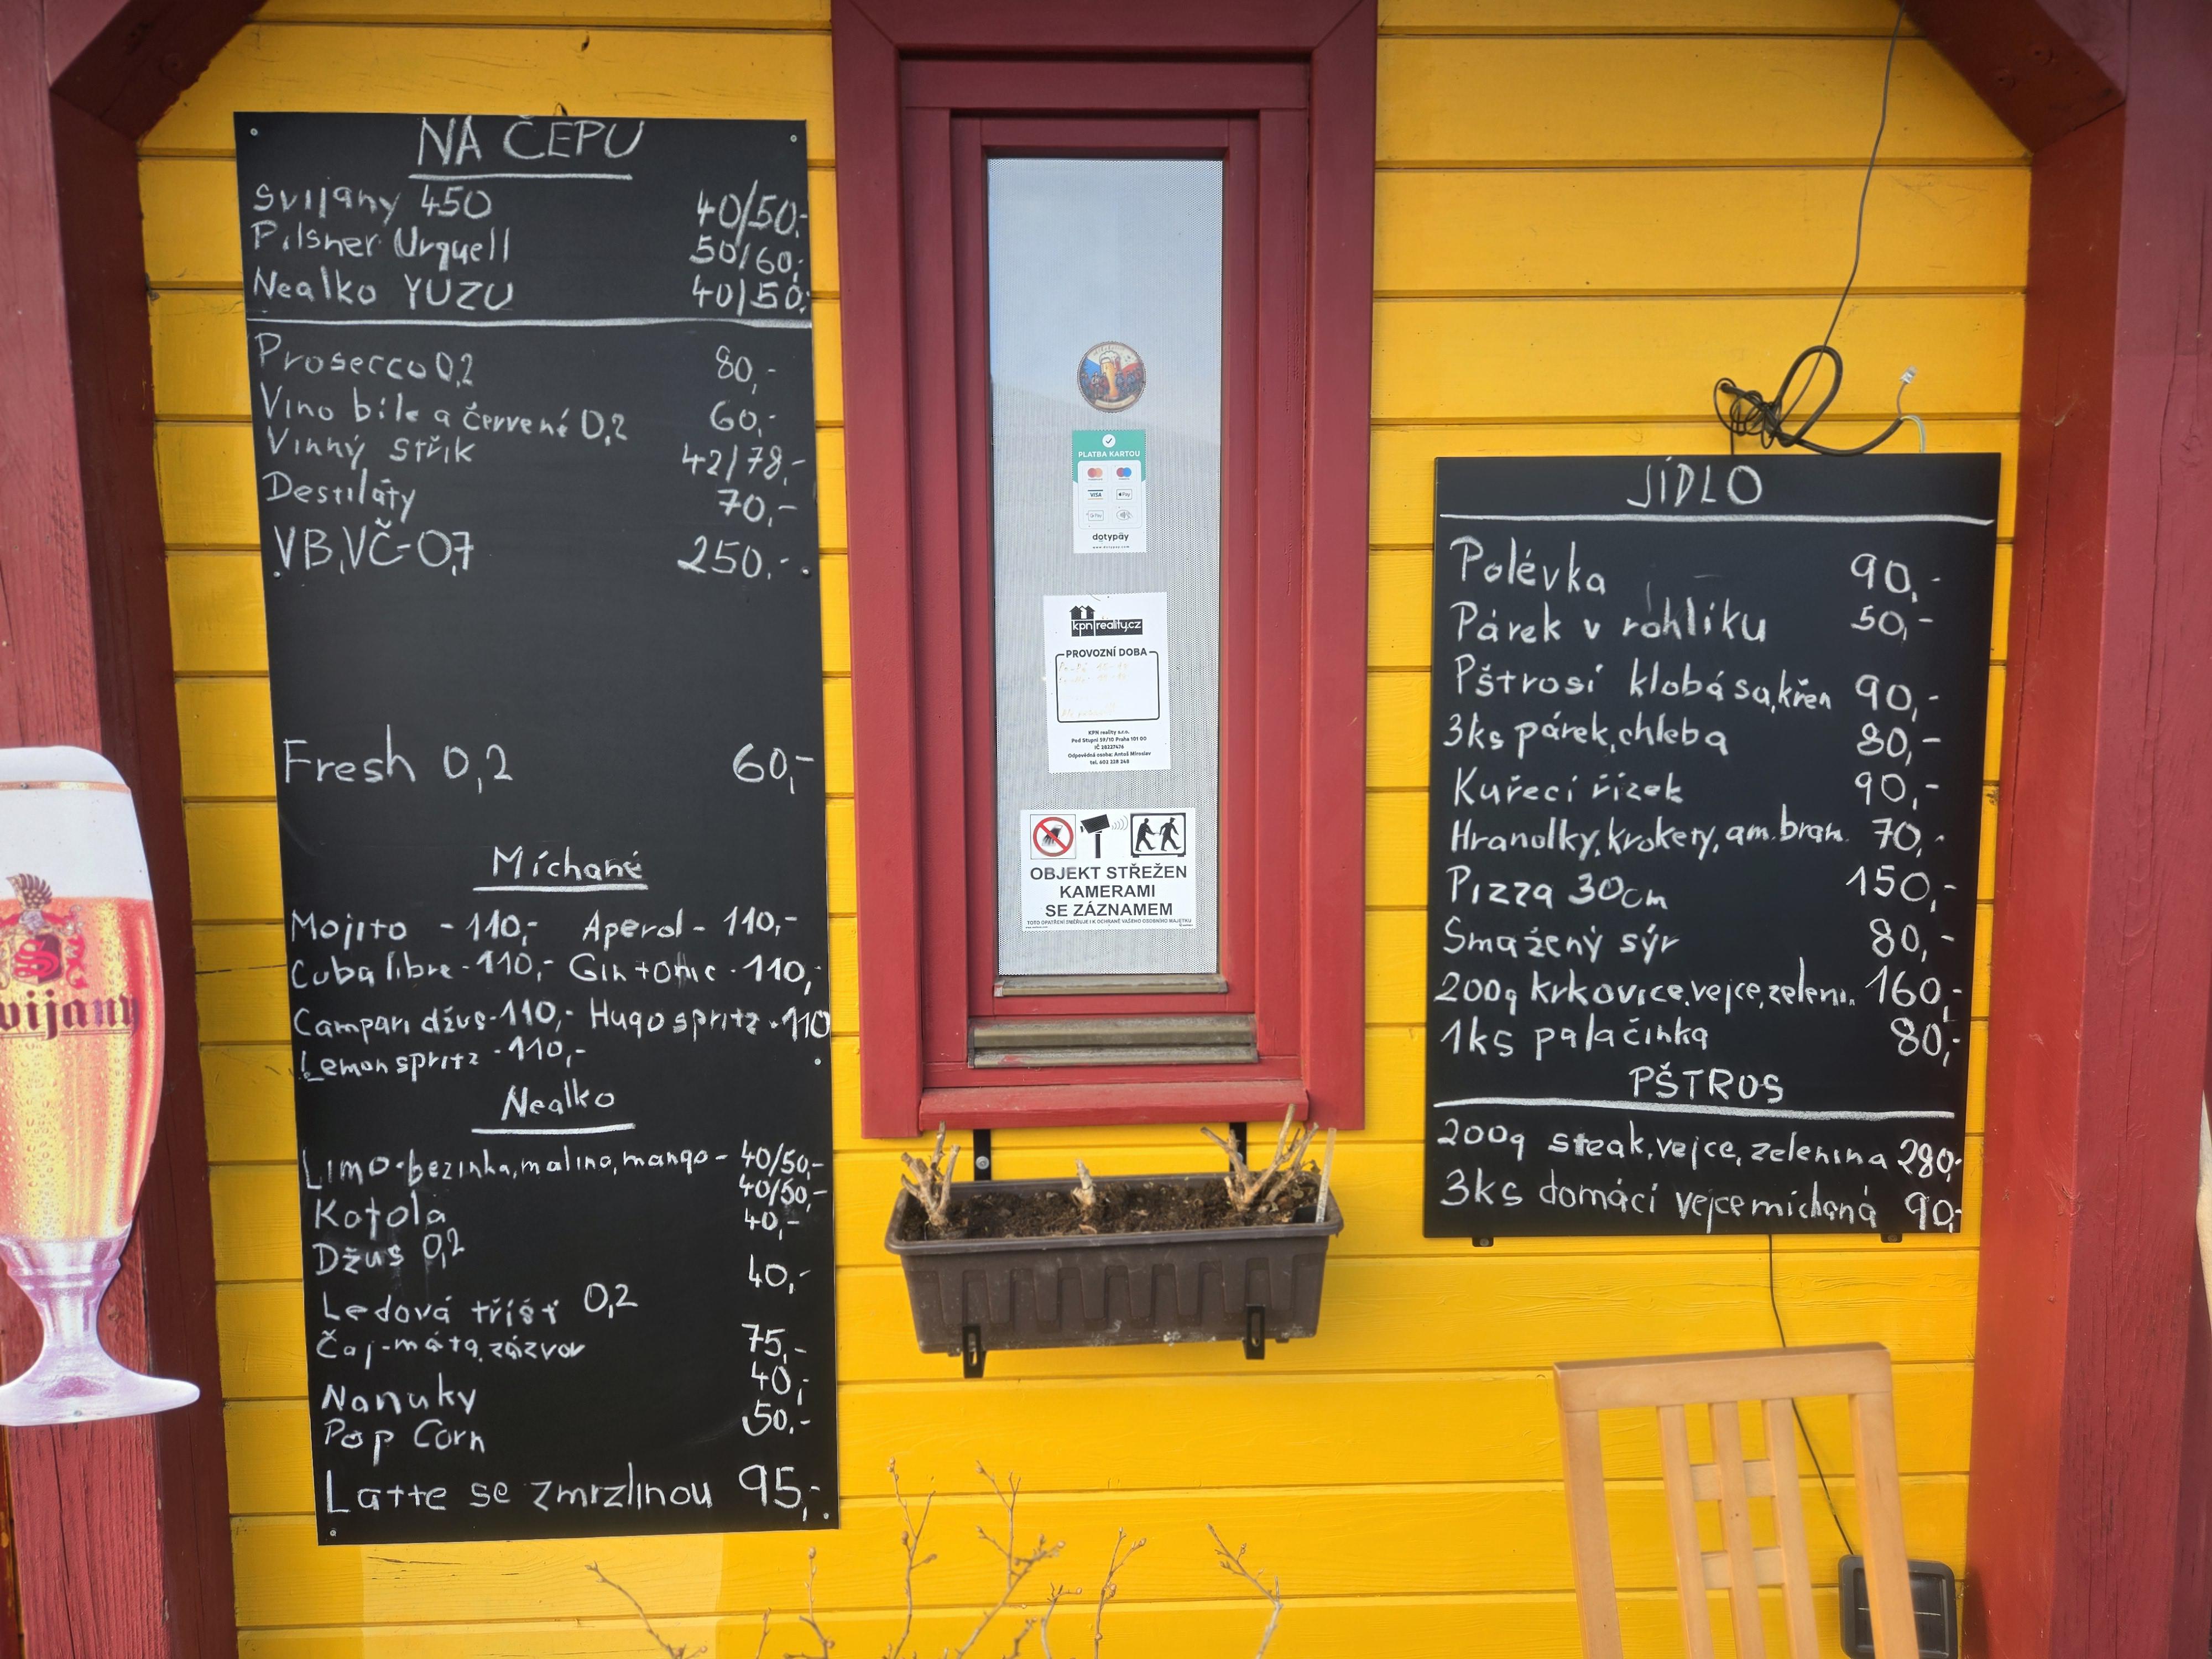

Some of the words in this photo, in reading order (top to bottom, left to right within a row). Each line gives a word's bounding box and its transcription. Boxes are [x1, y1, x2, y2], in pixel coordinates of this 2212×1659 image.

[418, 119, 482, 165] NA
[503, 114, 644, 159] ČEPU
[421, 184, 492, 219] 450
[252, 220, 380, 257] Pilsner
[254, 266, 376, 305] Nealko
[404, 274, 513, 311] YUZU
[255, 333, 426, 379] Prosecco
[436, 352, 472, 387] 0,2
[261, 382, 333, 420] Vino
[434, 410, 450, 427] a
[582, 409, 627, 446] 0,2
[268, 426, 365, 470] Vinný
[1627, 457, 1762, 508] JÍDLO
[717, 489, 796, 527] 70,-
[677, 535, 789, 580] 250,-
[1450, 536, 1605, 595] Polévka
[1851, 553, 1940, 603] 90,-
[1451, 601, 1561, 644] Párek
[1583, 619, 1600, 639] v
[1623, 597, 1766, 642] rohlíku
[1851, 605, 1933, 640] 50,-
[1066, 646, 1116, 658] PROVOZNÍ
[1119, 648, 1147, 656] DOBA
[1855, 674, 1939, 722] 90,-
[283, 724, 415, 783] Fresh
[444, 744, 513, 794] 0,2
[733, 743, 814, 794] 60,-
[1443, 712, 1504, 750] 3ks
[1857, 722, 1941, 766] 80,-
[1454, 766, 1577, 806] Kuřecí
[1855, 771, 1939, 810] 90,-
[1030, 867, 1101, 880] OBJEKT
[1106, 863, 1187, 879] STŘEŽEN
[1060, 885, 1155, 899] KAMERAMI
[1446, 865, 1552, 909] Pizza
[1846, 865, 1957, 912] 150,-
[292, 910, 406, 950] Mojito
[582, 908, 683, 951] Aperol
[1045, 904, 1068, 917] SE
[1073, 901, 1172, 916] ZÁZNAMEM
[1443, 916, 1603, 963] Smažený
[1620, 924, 1679, 964] sýr
[1870, 919, 1954, 962] 80,-
[293, 956, 374, 988] Cuba
[387, 951, 452, 980] libre
[569, 953, 627, 982] Gin
[295, 1008, 410, 1044] Campari
[591, 998, 664, 1039] Hugo
[1441, 1016, 1513, 1057] 1ks
[1891, 1017, 1960, 1067] 80,-
[302, 1051, 388, 1082] Lemon
[1629, 1062, 1783, 1104] PŠTROS
[501, 1078, 614, 1121] Nealko
[1441, 1167, 1523, 1206] 3ks
[1540, 1169, 1657, 1213] domácí
[745, 1208, 800, 1240] 40,-
[324, 1292, 452, 1323] Ledová
[584, 1282, 638, 1318] 0,2
[749, 1254, 810, 1294] 40,-
[742, 1323, 806, 1364] 75,-
[322, 1373, 476, 1415] Nanuky
[751, 1361, 808, 1405] 40,-
[742, 1399, 810, 1436] 50,-
[326, 1470, 446, 1512] Latte
[470, 1482, 510, 1507] se
[739, 1464, 820, 1521] 95,-
